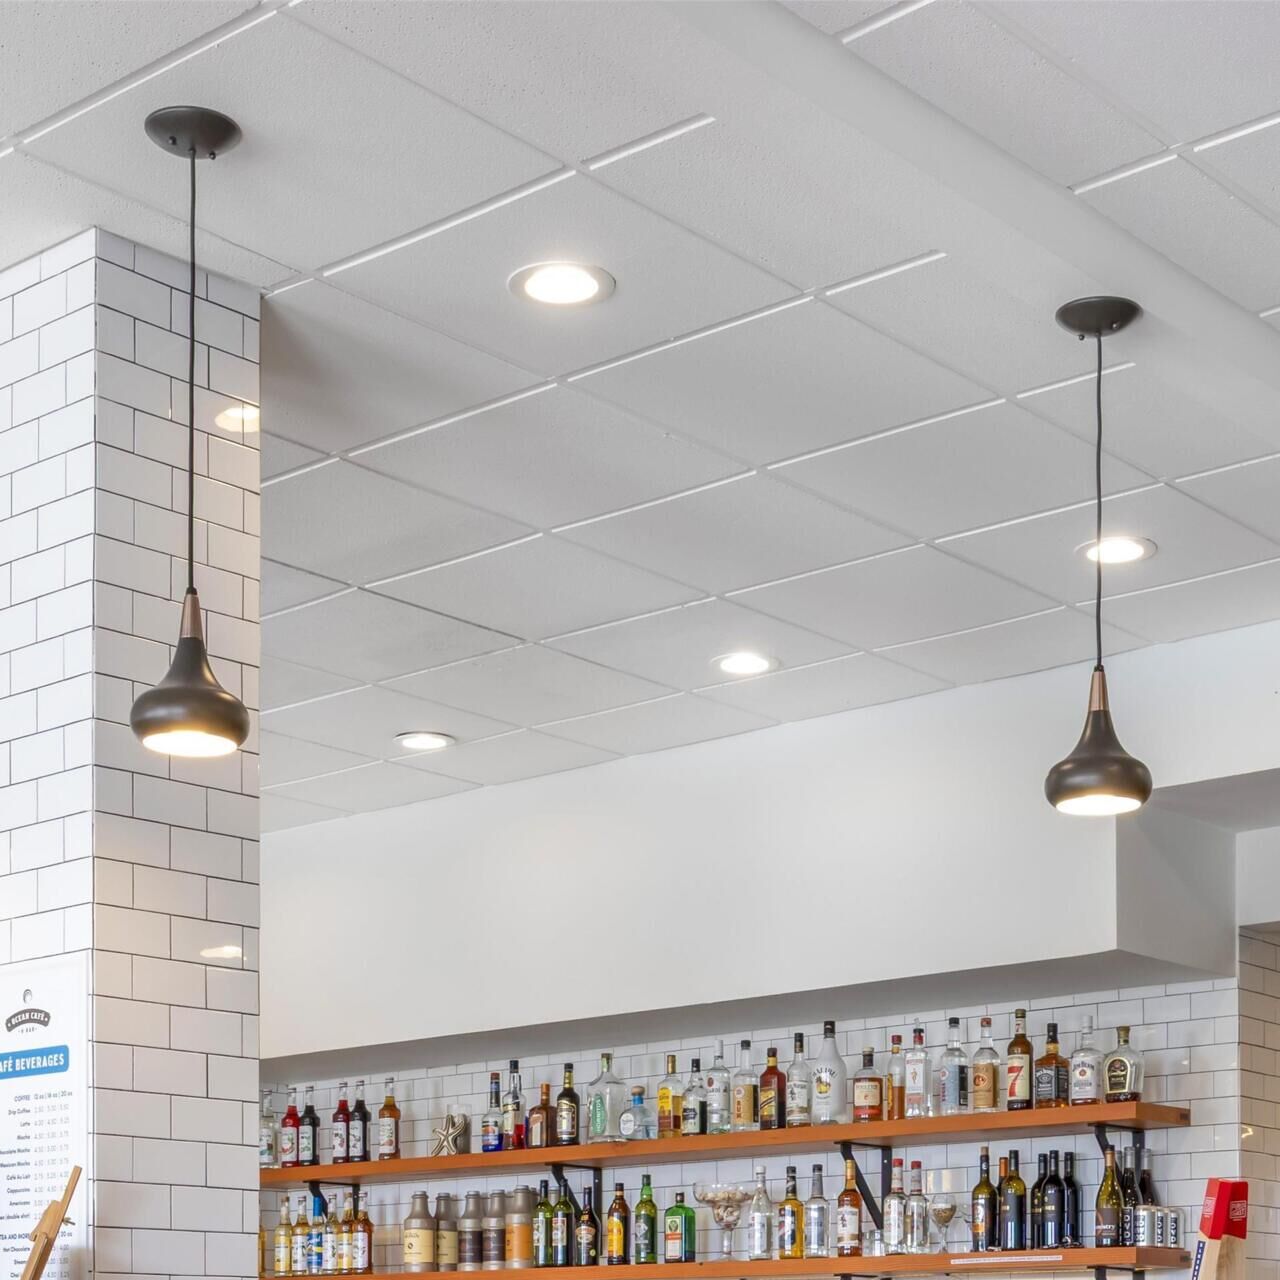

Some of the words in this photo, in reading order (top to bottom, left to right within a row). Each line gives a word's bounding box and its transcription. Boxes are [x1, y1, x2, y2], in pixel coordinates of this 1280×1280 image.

[11, 1012, 30, 1025] OCEAN
[30, 1011, 45, 1021] CAFÉ
[15, 1053, 65, 1071] BEVERAGES
[1008, 1065, 1024, 1098] 7
